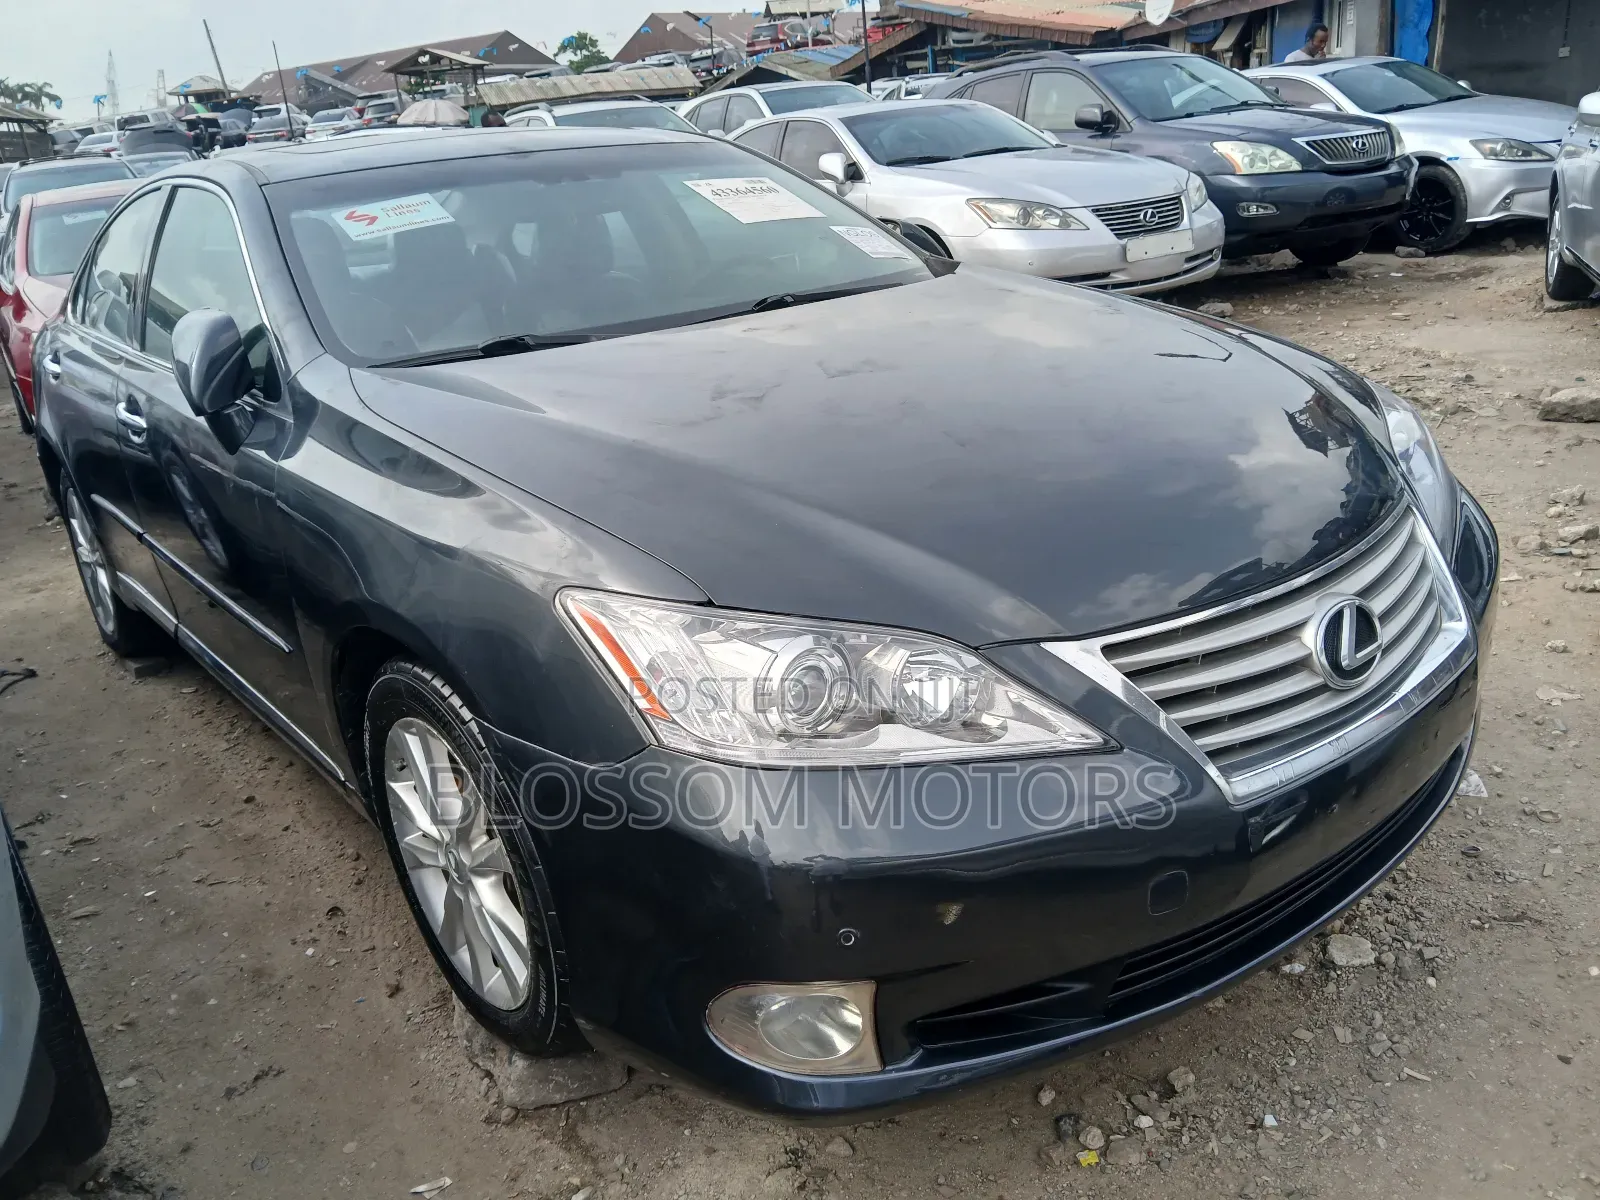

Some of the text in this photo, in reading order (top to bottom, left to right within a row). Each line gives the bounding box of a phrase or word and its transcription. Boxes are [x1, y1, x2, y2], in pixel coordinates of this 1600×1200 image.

[381, 200, 432, 213] Sallaum
[386, 209, 421, 218] Lines
[354, 216, 450, 237] www.sallaumlines.com
